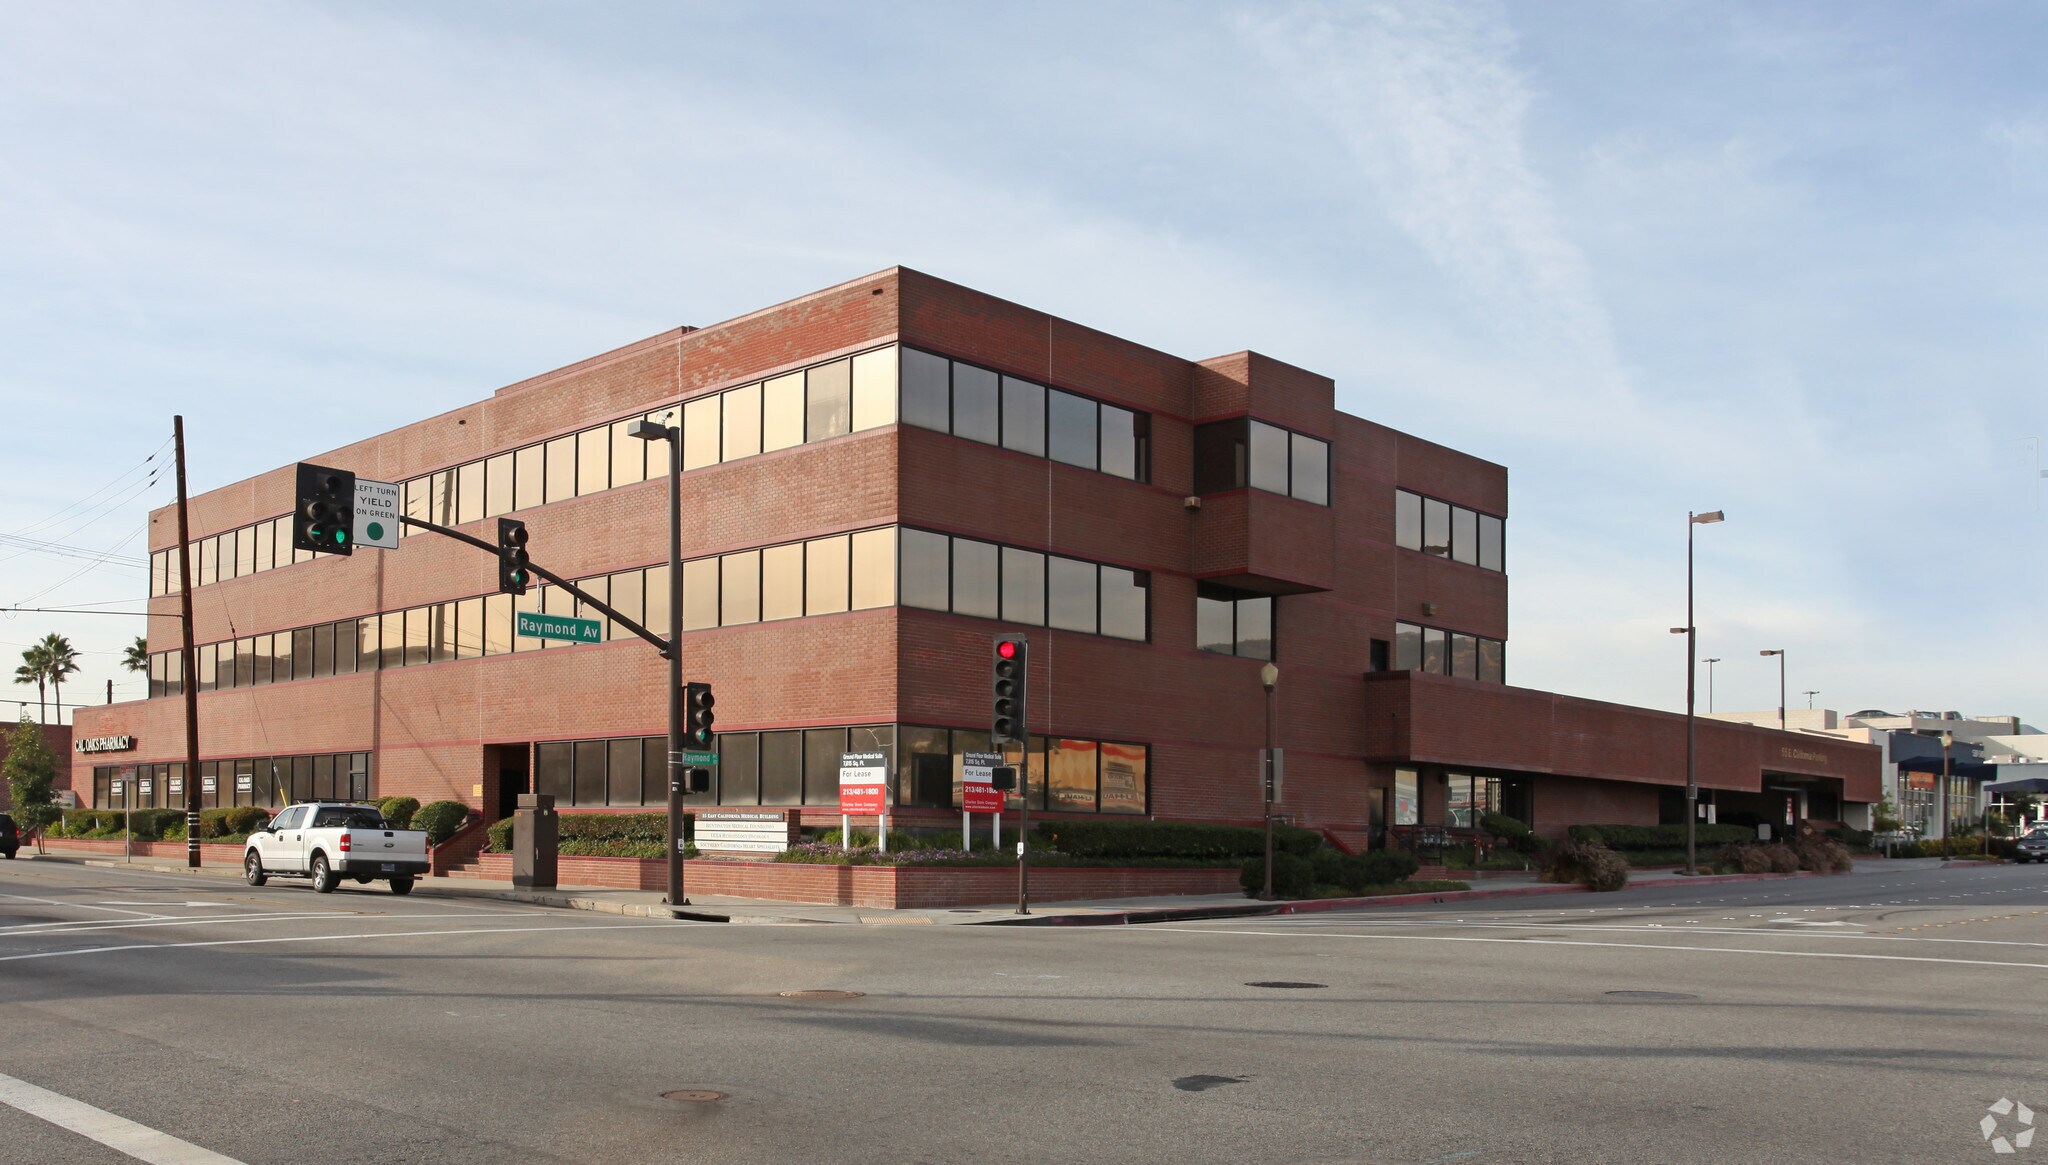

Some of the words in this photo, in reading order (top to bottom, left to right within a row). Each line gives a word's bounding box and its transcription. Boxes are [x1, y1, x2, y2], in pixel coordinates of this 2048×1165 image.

[376, 487, 397, 496] TURN
[360, 496, 392, 508] YIELD
[369, 510, 395, 519] GREEN
[520, 617, 577, 636] Raymond
[583, 625, 598, 638] Av
[75, 739, 85, 752] CAL
[85, 738, 100, 751] OAKS
[99, 735, 130, 751] PHARMACY
[976, 769, 992, 777] Lease
[842, 788, 879, 796] 213/481-1800
